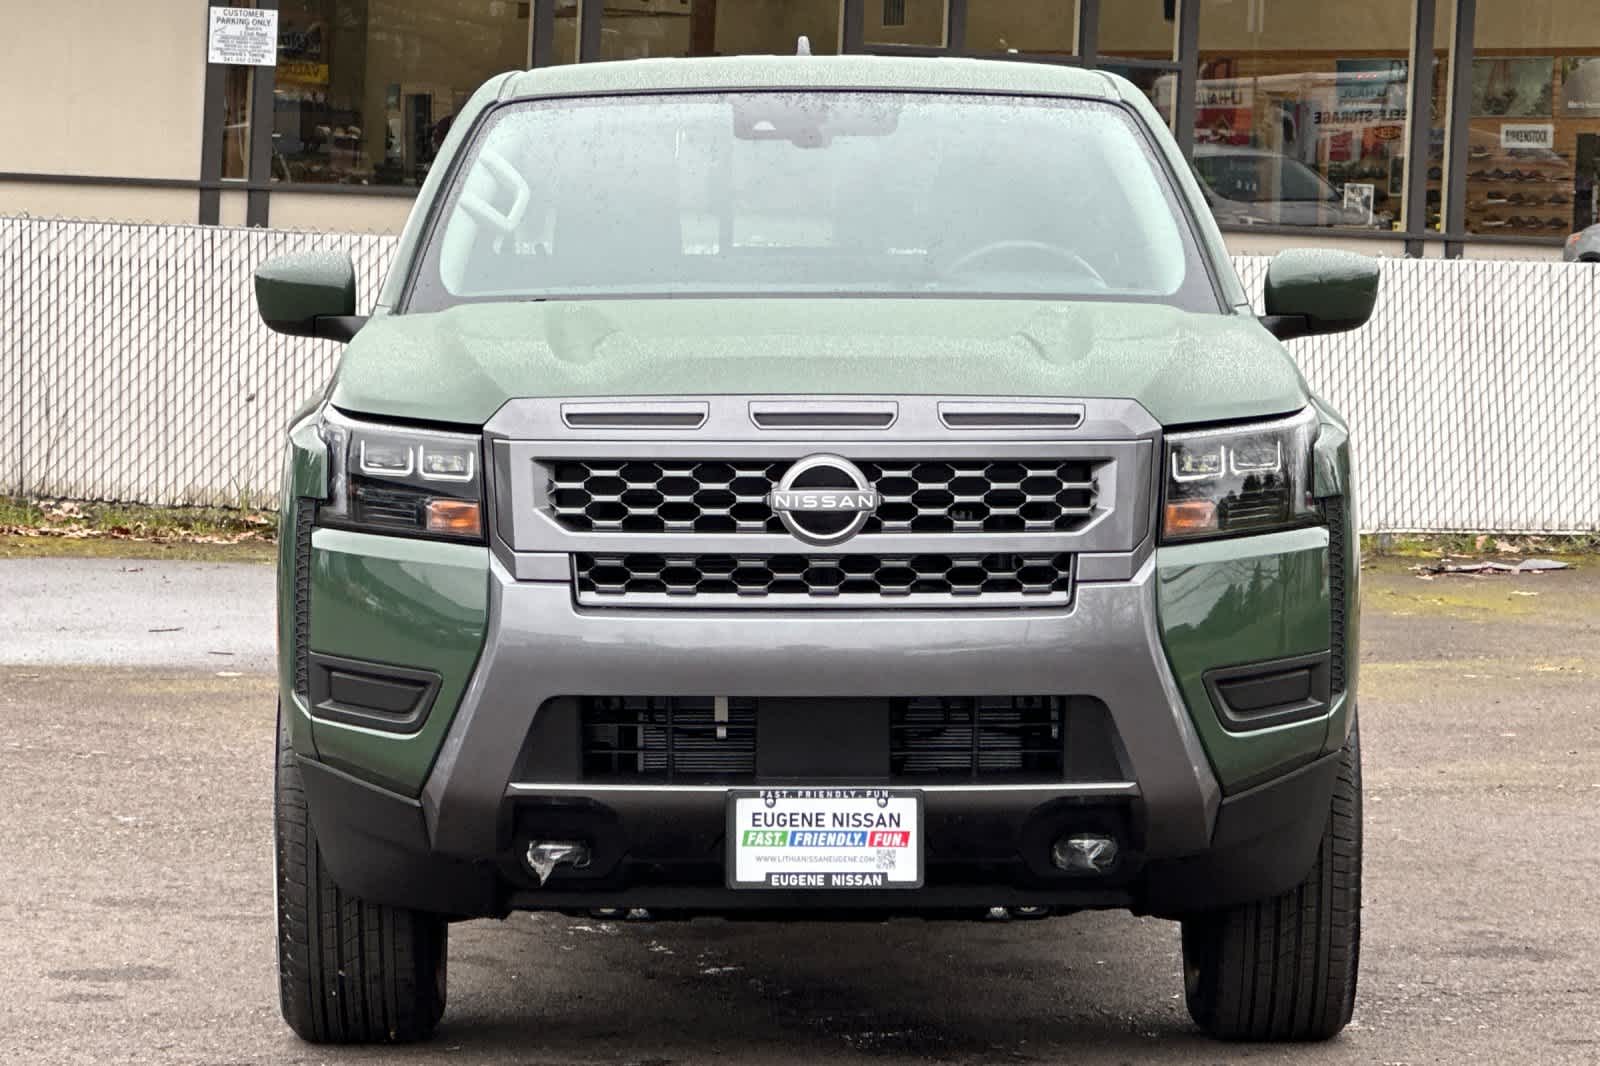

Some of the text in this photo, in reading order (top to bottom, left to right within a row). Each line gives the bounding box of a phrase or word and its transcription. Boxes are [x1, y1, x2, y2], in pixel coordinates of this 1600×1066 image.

[223, 9, 265, 17] CUSTOMER
[216, 16, 271, 26] PARKING ONLY
[775, 495, 874, 508] NISSAN
[760, 790, 793, 799] FAST.
[797, 790, 863, 799] FRIENDLY.
[751, 812, 901, 828] EUGENE NISSAN
[747, 832, 907, 848] FAST. FRIENDLY. FUN.
[771, 874, 883, 886] EUGENE NISSAN
